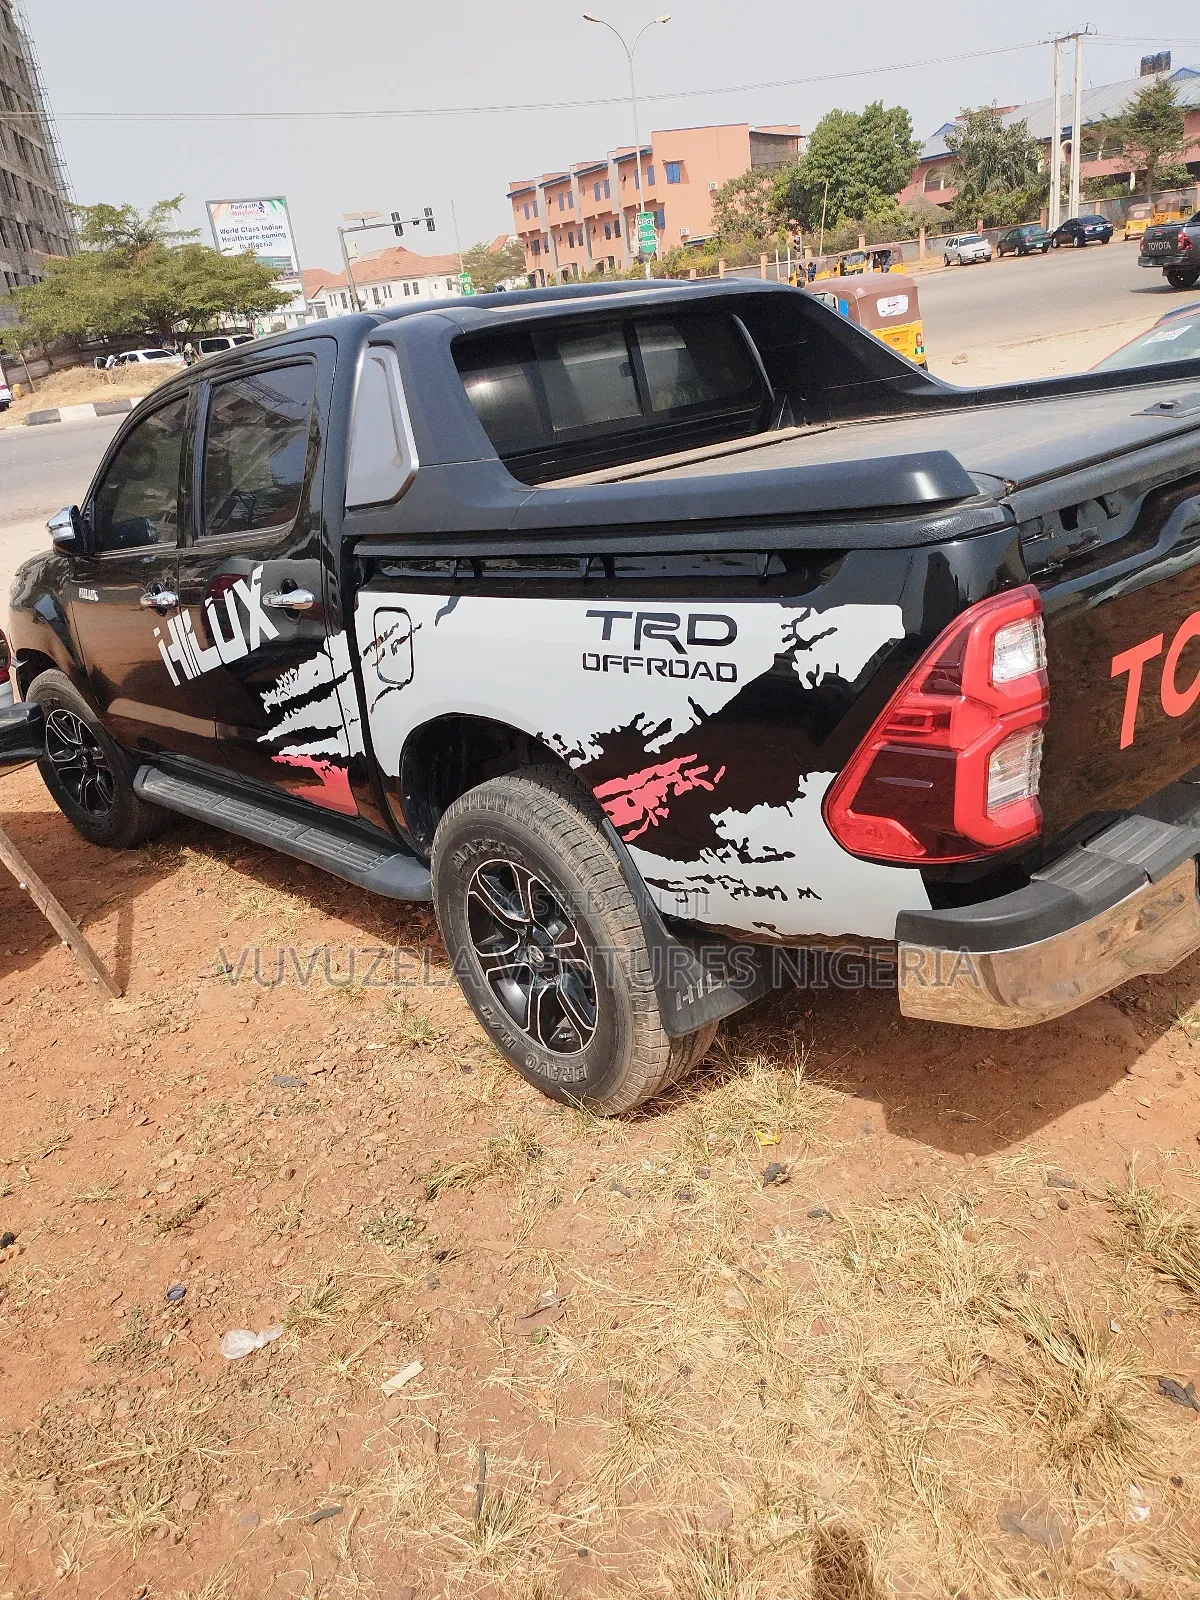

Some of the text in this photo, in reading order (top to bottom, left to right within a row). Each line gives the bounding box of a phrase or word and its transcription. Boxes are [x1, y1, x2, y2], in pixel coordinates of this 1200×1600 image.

[220, 227, 239, 235] World
[262, 223, 283, 231] Indian
[222, 231, 287, 243] Healthcare coming
[247, 241, 273, 250] Nigeria
[1147, 241, 1172, 251] TOYOTA
[585, 609, 738, 655] TRD
[582, 652, 738, 683] OFFROAD
